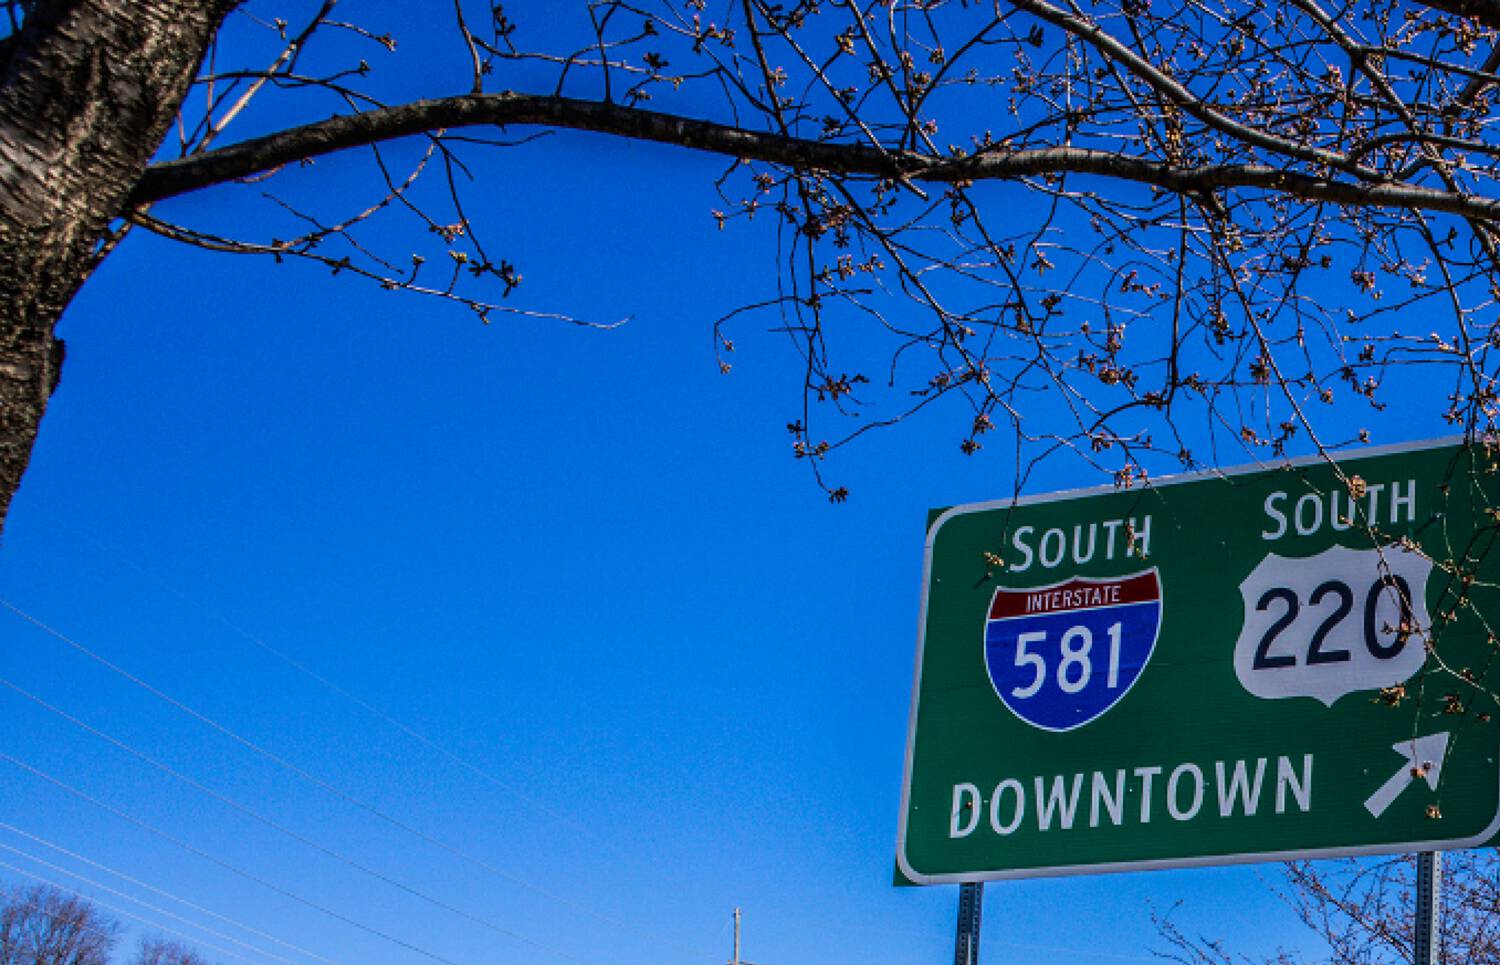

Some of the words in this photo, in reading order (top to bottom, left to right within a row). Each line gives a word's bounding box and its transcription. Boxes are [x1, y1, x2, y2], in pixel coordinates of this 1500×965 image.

[1009, 514, 1152, 572] SOUTH
[1262, 479, 1416, 540] SOUTH
[1025, 585, 1122, 612] INTERSTATE
[1253, 574, 1412, 670] 220
[1011, 621, 1122, 699] 581
[949, 753, 1314, 838] DOWNTOWN
